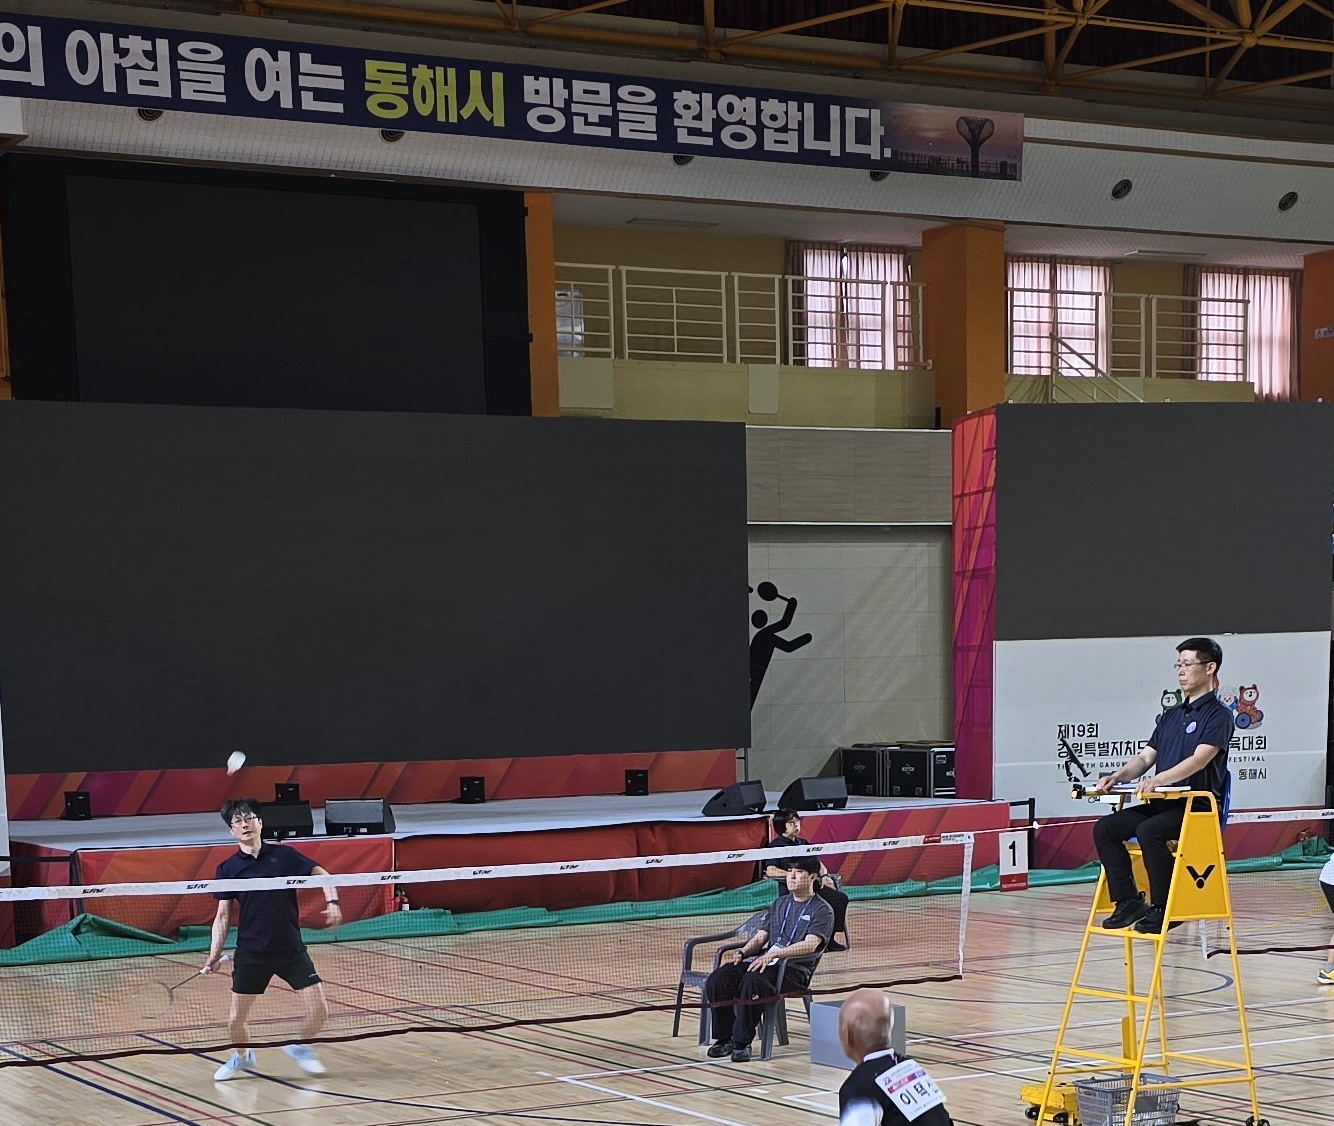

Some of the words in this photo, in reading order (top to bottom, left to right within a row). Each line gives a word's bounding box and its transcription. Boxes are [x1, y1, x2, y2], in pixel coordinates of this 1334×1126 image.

[66, 34, 226, 104] 아침을
[243, 41, 345, 114] 여는
[363, 59, 506, 128] 동해시
[523, 75, 659, 140] 방문을
[673, 88, 893, 160] 환영합니다.
[1057, 722, 1099, 740] 제19회
[1228, 755, 1266, 763] FESTIVAL
[1238, 767, 1267, 780] 동해시
[1008, 840, 1017, 867] 1
